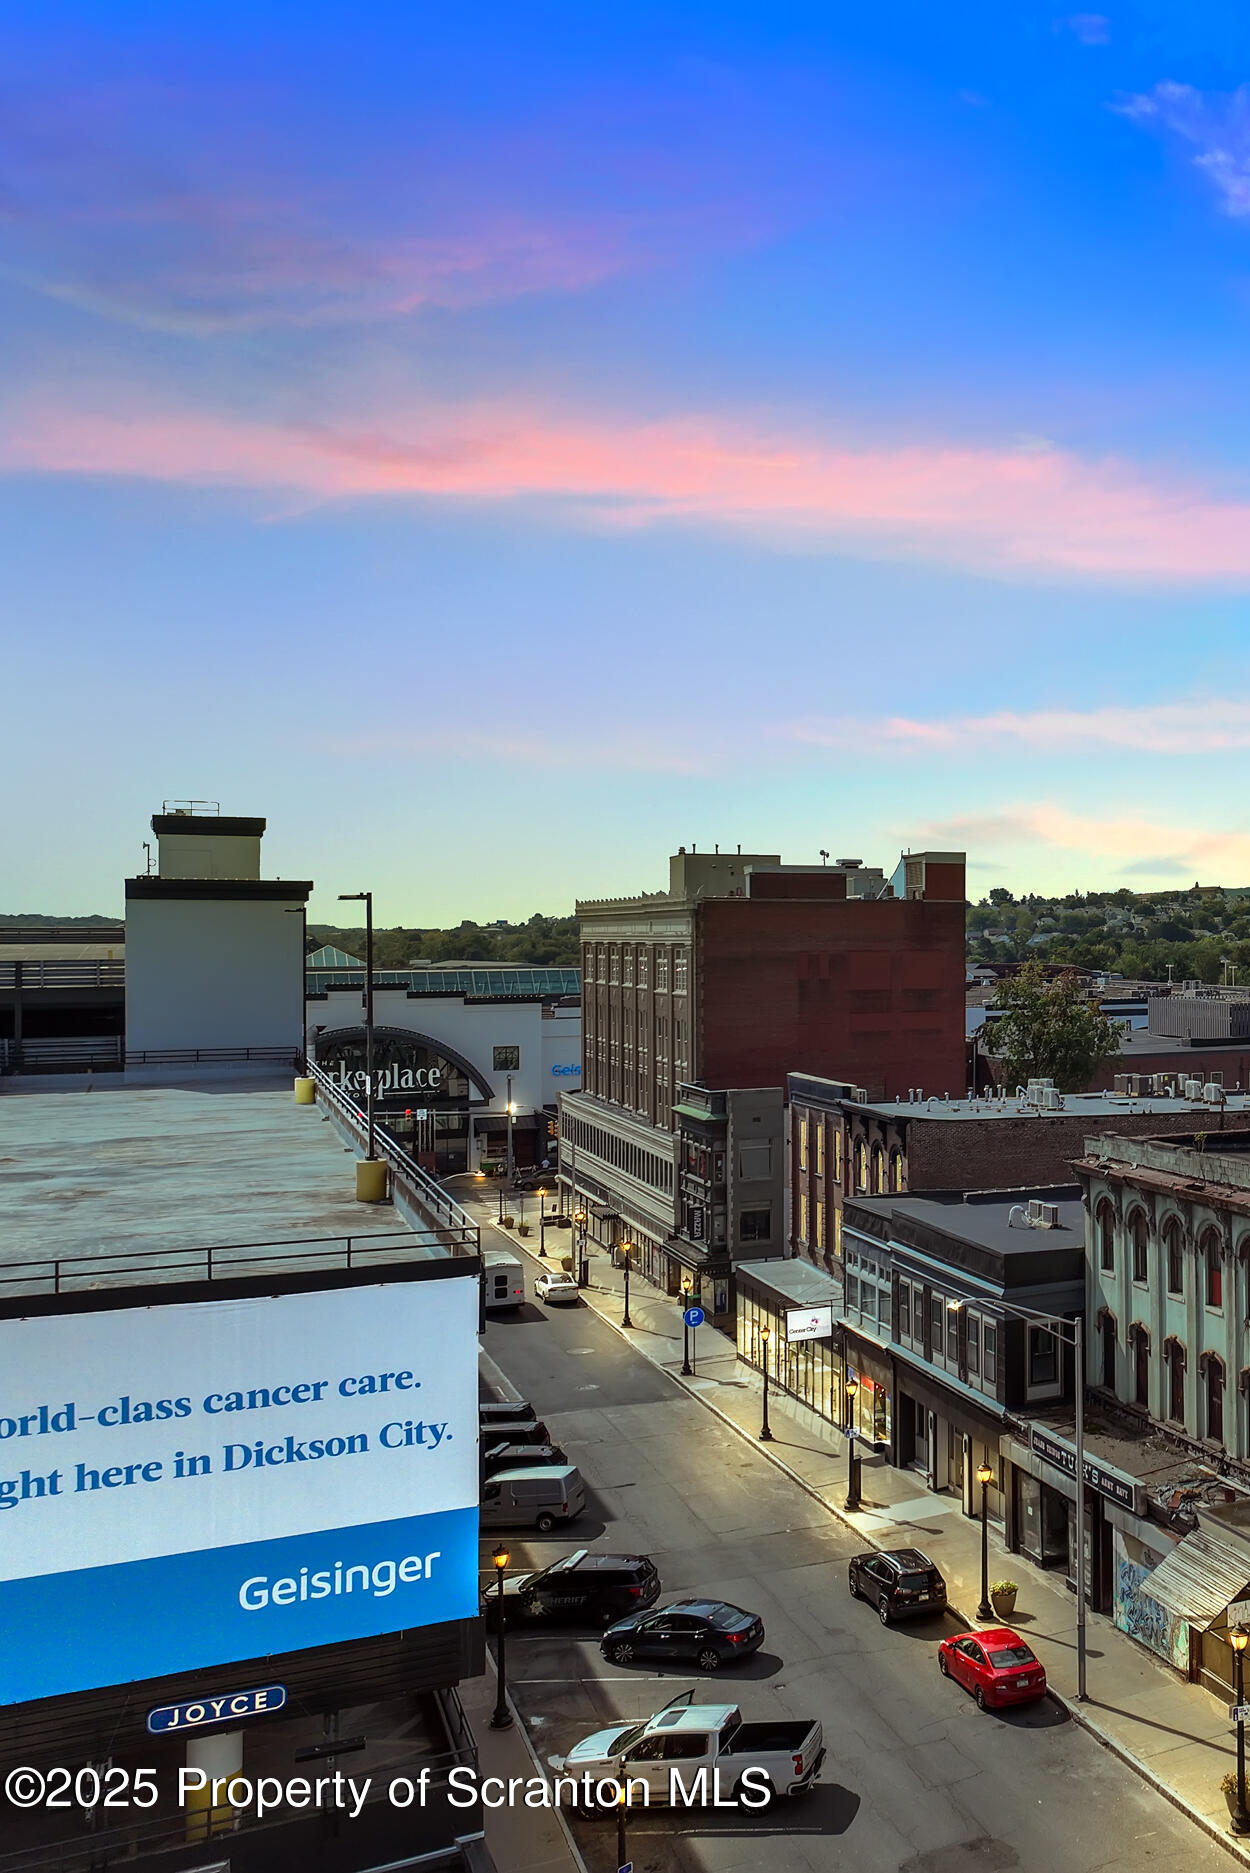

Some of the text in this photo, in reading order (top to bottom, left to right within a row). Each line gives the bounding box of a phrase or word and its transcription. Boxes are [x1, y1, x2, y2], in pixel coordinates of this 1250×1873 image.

[690, 1310, 699, 1321] P
[0, 1370, 421, 1439] orld-class cancer care.
[74, 1460, 163, 1492] here
[173, 1451, 213, 1479] in
[222, 1433, 370, 1472] Dickson
[379, 1420, 453, 1450] City.
[239, 1551, 441, 1611] Geisinger
[167, 1691, 268, 1727] JOYCE
